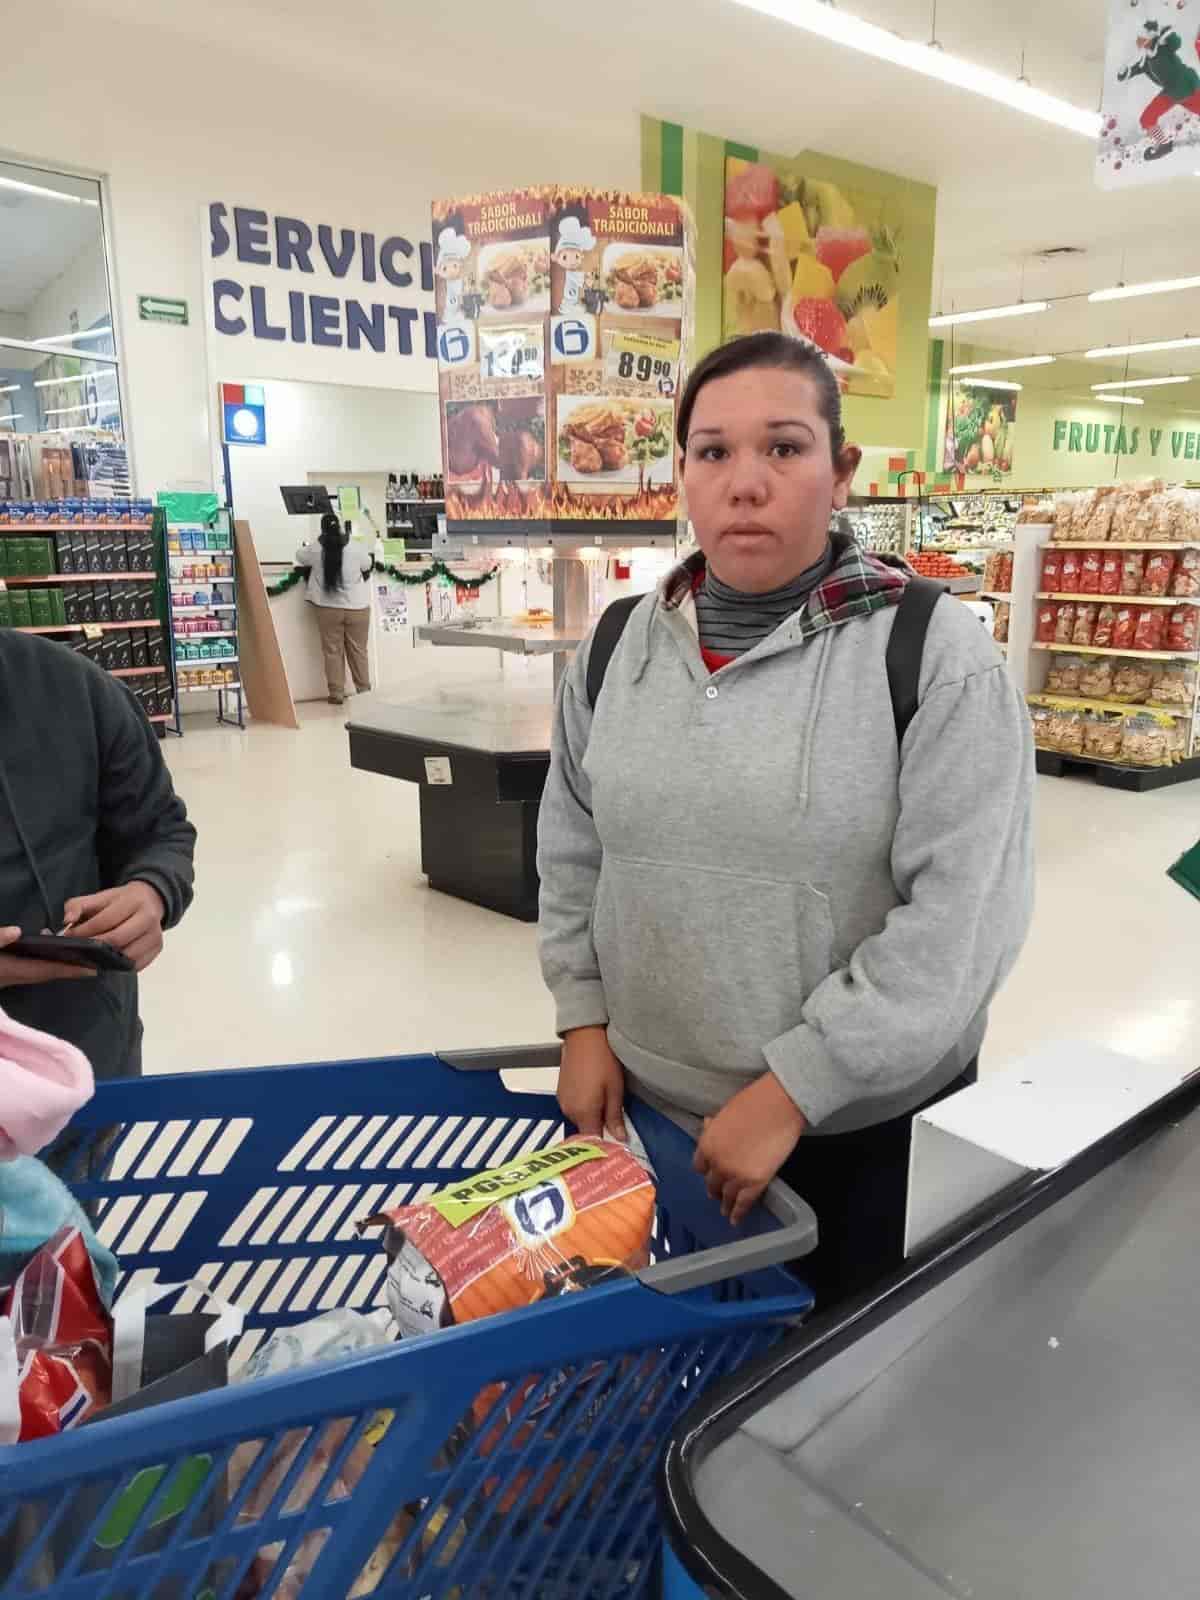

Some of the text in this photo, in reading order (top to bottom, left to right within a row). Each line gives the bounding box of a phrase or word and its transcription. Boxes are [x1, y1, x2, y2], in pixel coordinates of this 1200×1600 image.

[481, 202, 517, 220] SABOR
[608, 206, 649, 221] SABOR
[1053, 419, 1140, 455] FRUTAS
[1150, 428, 1162, 457] Y
